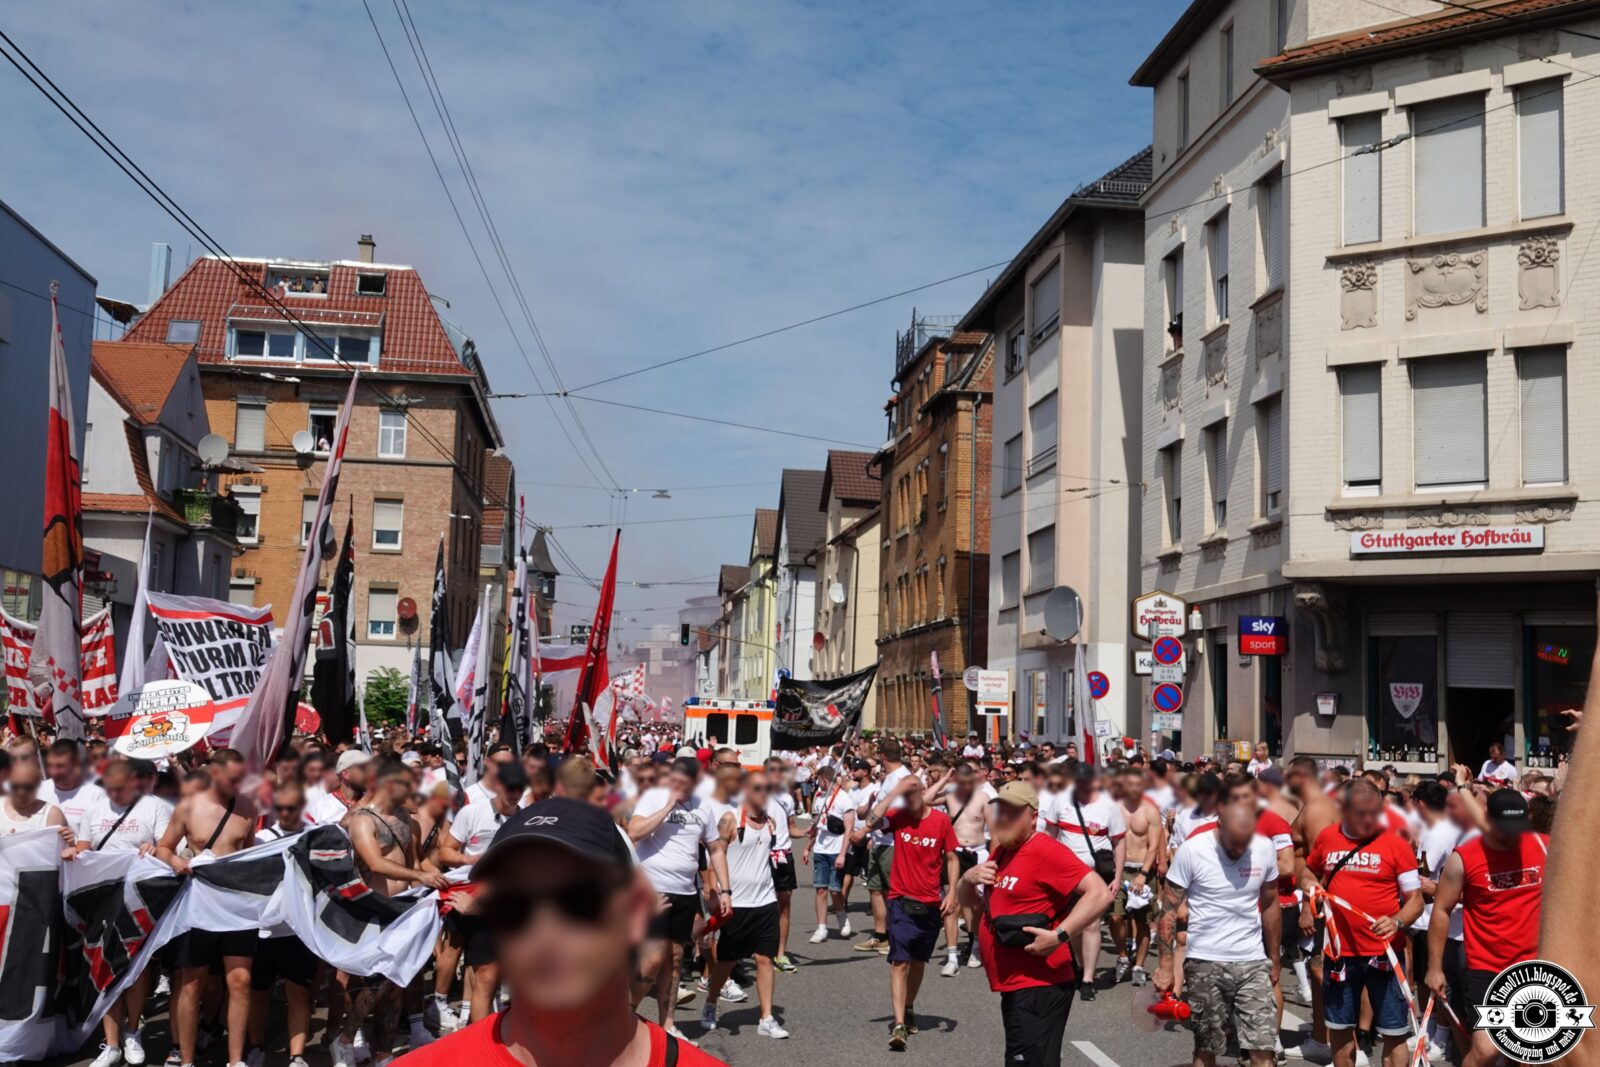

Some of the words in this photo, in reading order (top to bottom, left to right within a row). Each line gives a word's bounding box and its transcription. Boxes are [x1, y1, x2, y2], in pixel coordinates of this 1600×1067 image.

[1360, 531, 1455, 550] Stuttgarter
[1461, 528, 1532, 548] Hofbräu
[1252, 619, 1275, 635] sky
[1250, 641, 1276, 650] sport
[171, 642, 247, 675] STURM
[133, 694, 187, 711] ULTRAS
[112, 712, 131, 720] EGAL
[1326, 850, 1369, 866] ULTAS
